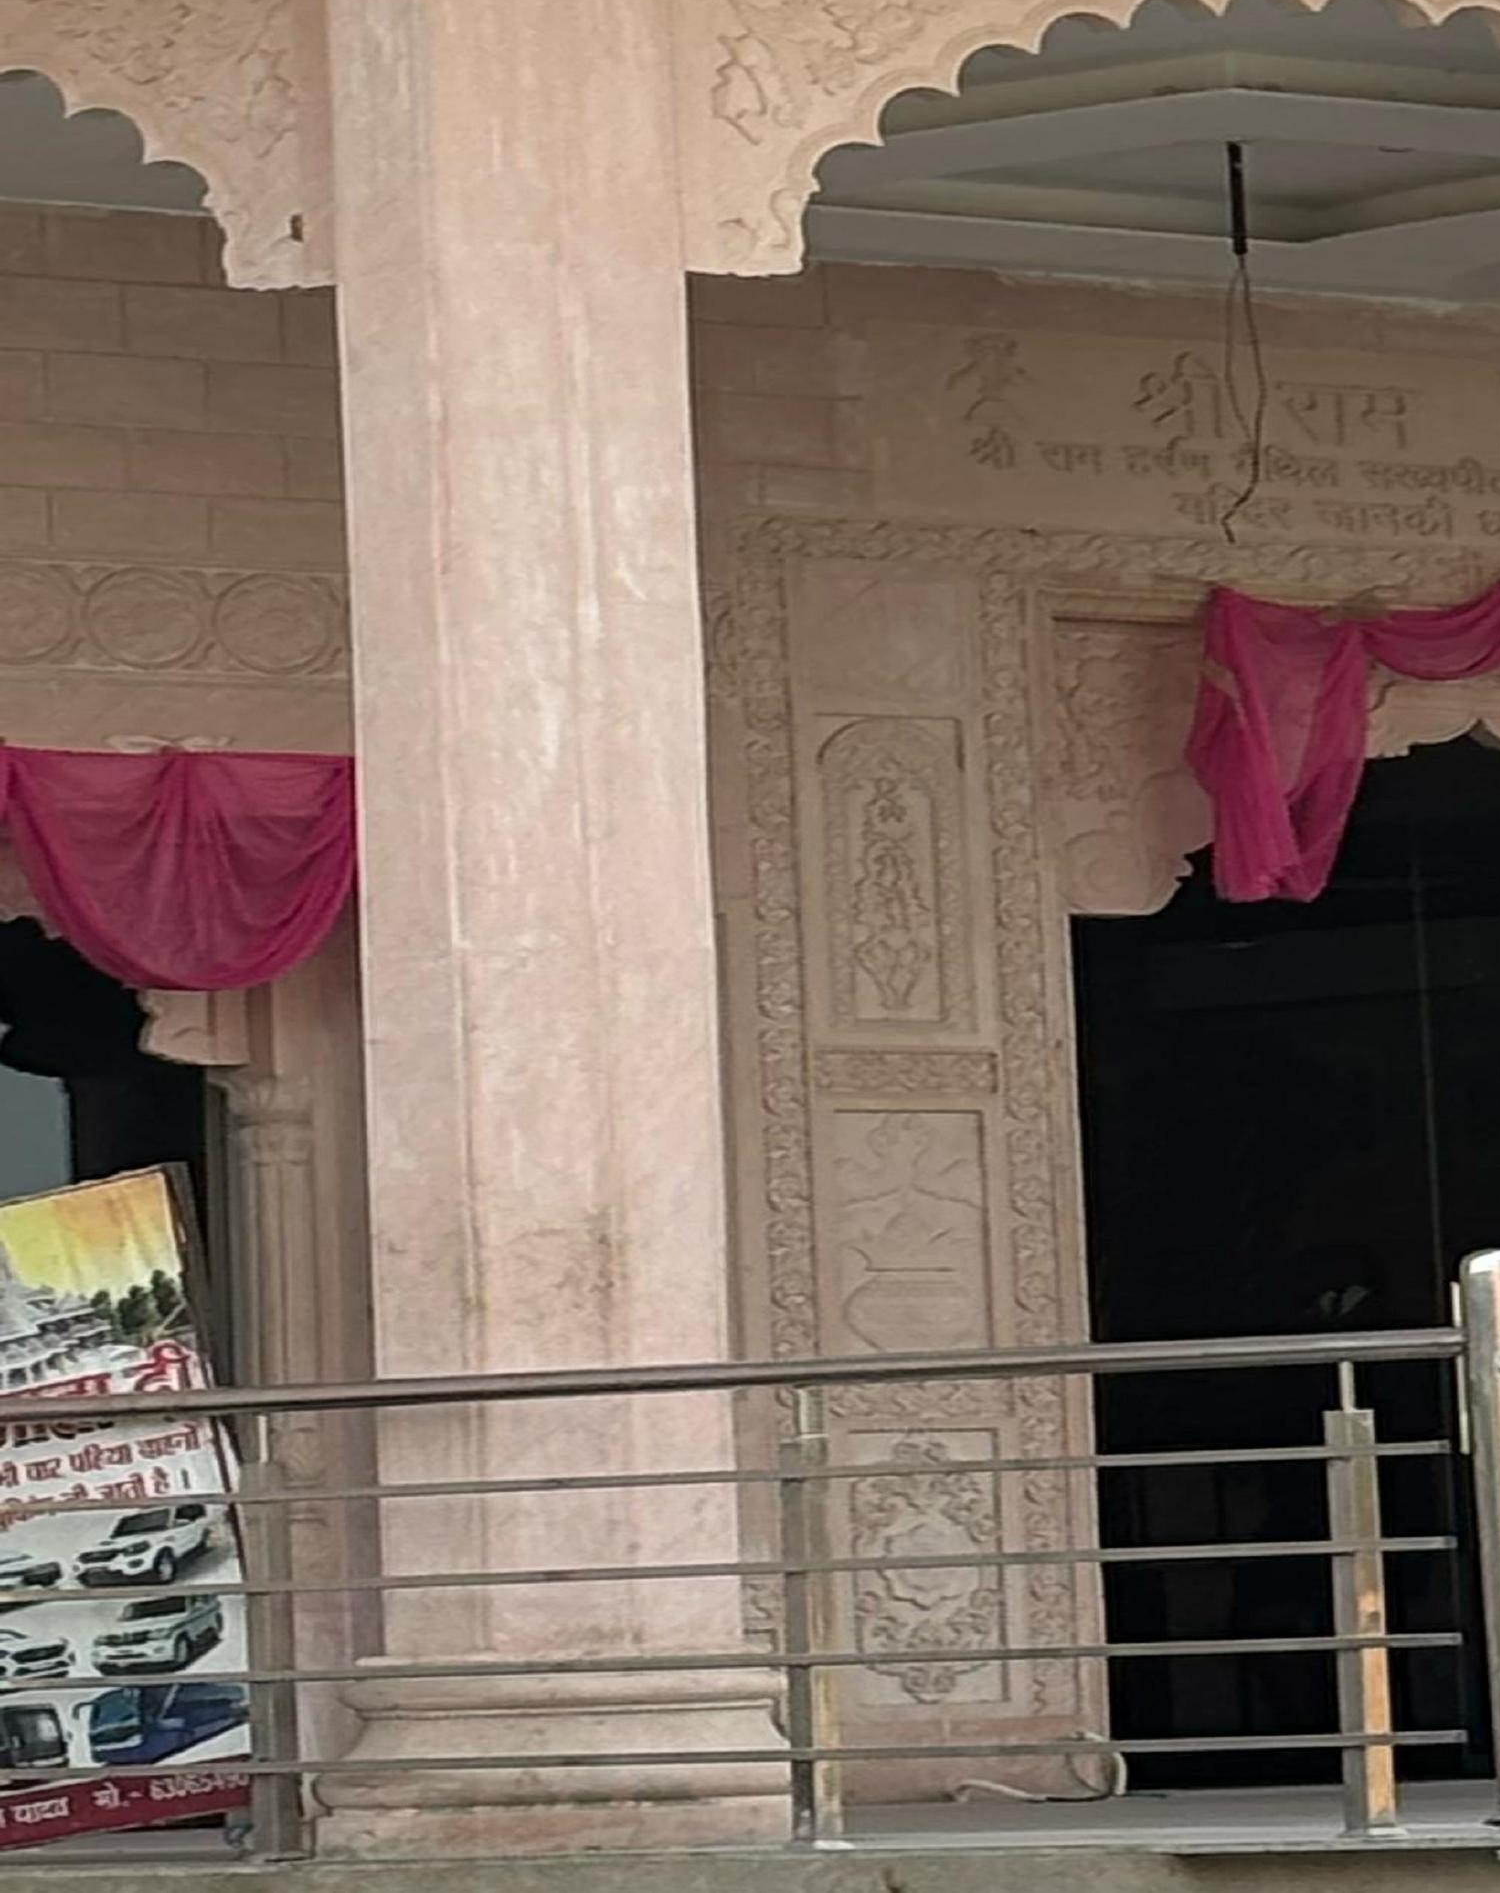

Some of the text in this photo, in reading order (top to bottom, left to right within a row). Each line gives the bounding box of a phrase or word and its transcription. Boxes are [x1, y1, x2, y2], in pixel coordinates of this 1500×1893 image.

[1131, 350, 1226, 439] श्री
[1272, 380, 1424, 451] राम
[968, 427, 1018, 473] श्री
[1034, 440, 1104, 477] राम
[152, 1466, 172, 1495] है
